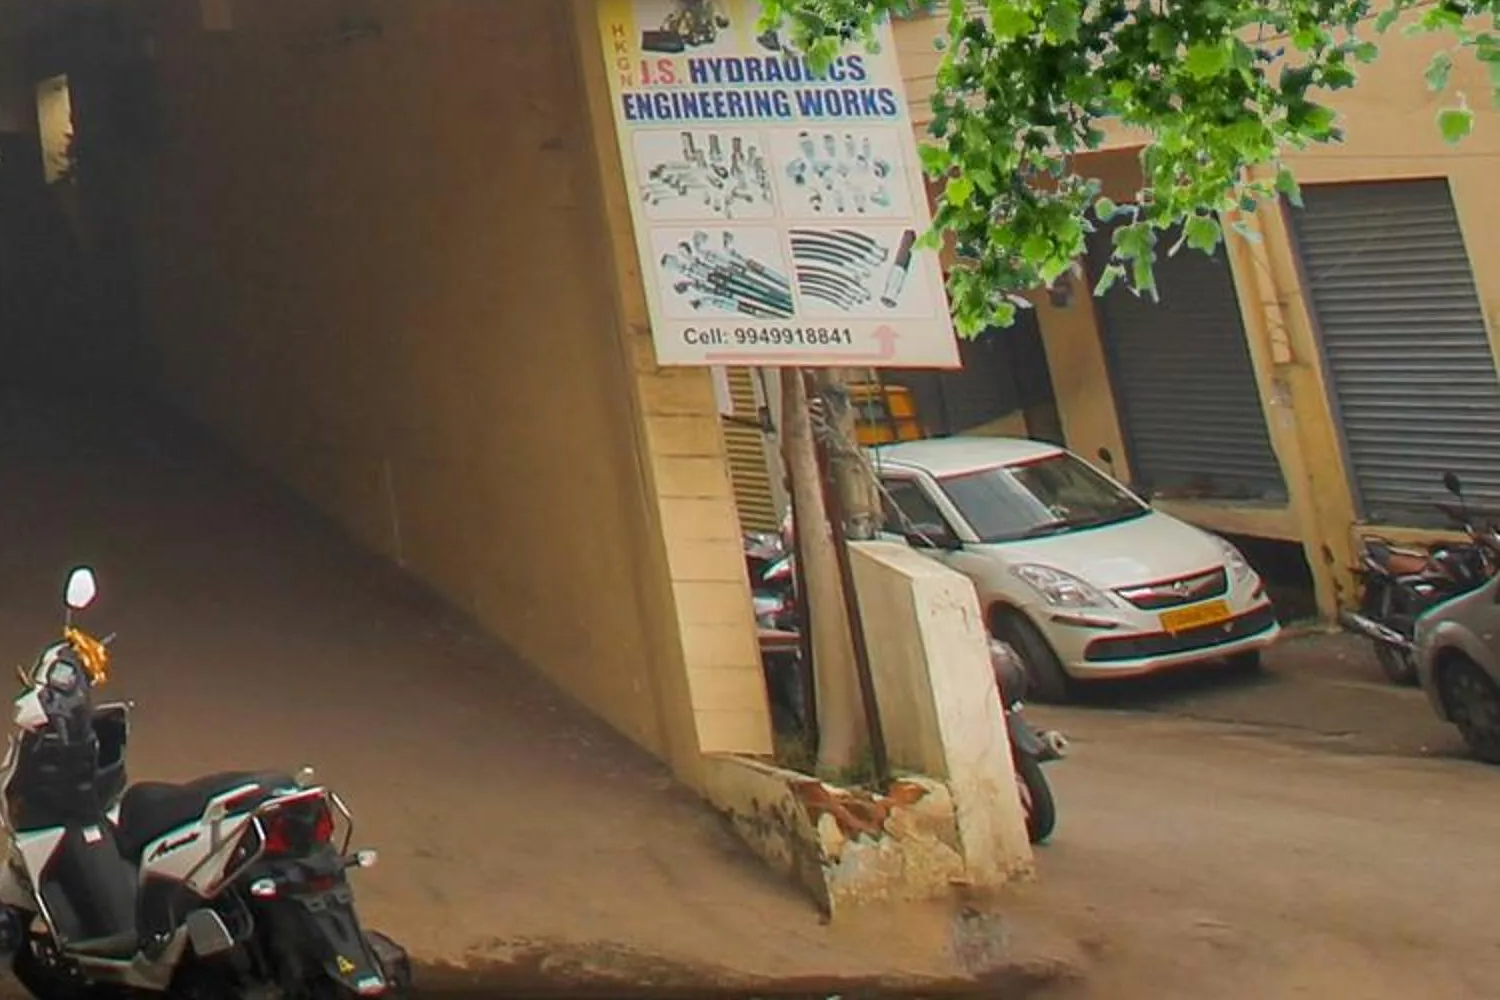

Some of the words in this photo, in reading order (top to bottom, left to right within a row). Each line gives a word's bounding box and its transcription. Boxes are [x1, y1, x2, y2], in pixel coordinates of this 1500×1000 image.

[688, 55, 866, 84] HYDRAULCS
[622, 89, 791, 121] ENGINEERING
[794, 88, 897, 117] WORKS
[683, 327, 728, 345] Cell:
[734, 327, 853, 345] 9949918841
